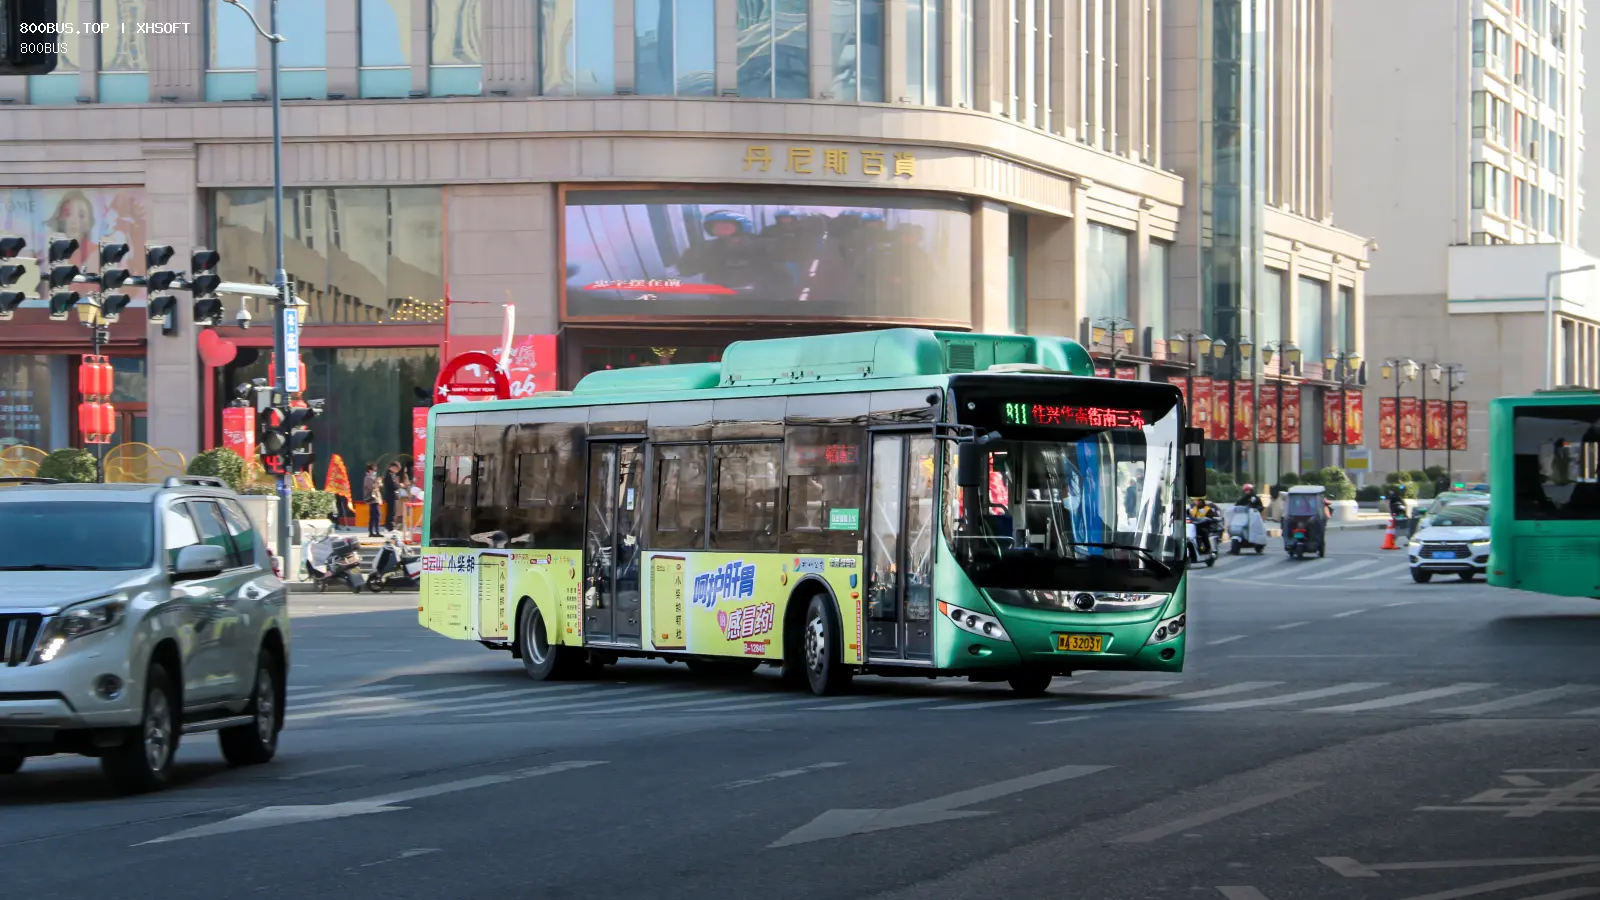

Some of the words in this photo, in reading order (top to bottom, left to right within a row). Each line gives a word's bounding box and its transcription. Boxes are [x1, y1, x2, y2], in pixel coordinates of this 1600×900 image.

[743, 145, 916, 178] 丹尼斯百貨
[692, 561, 756, 608] 呵护肝胃
